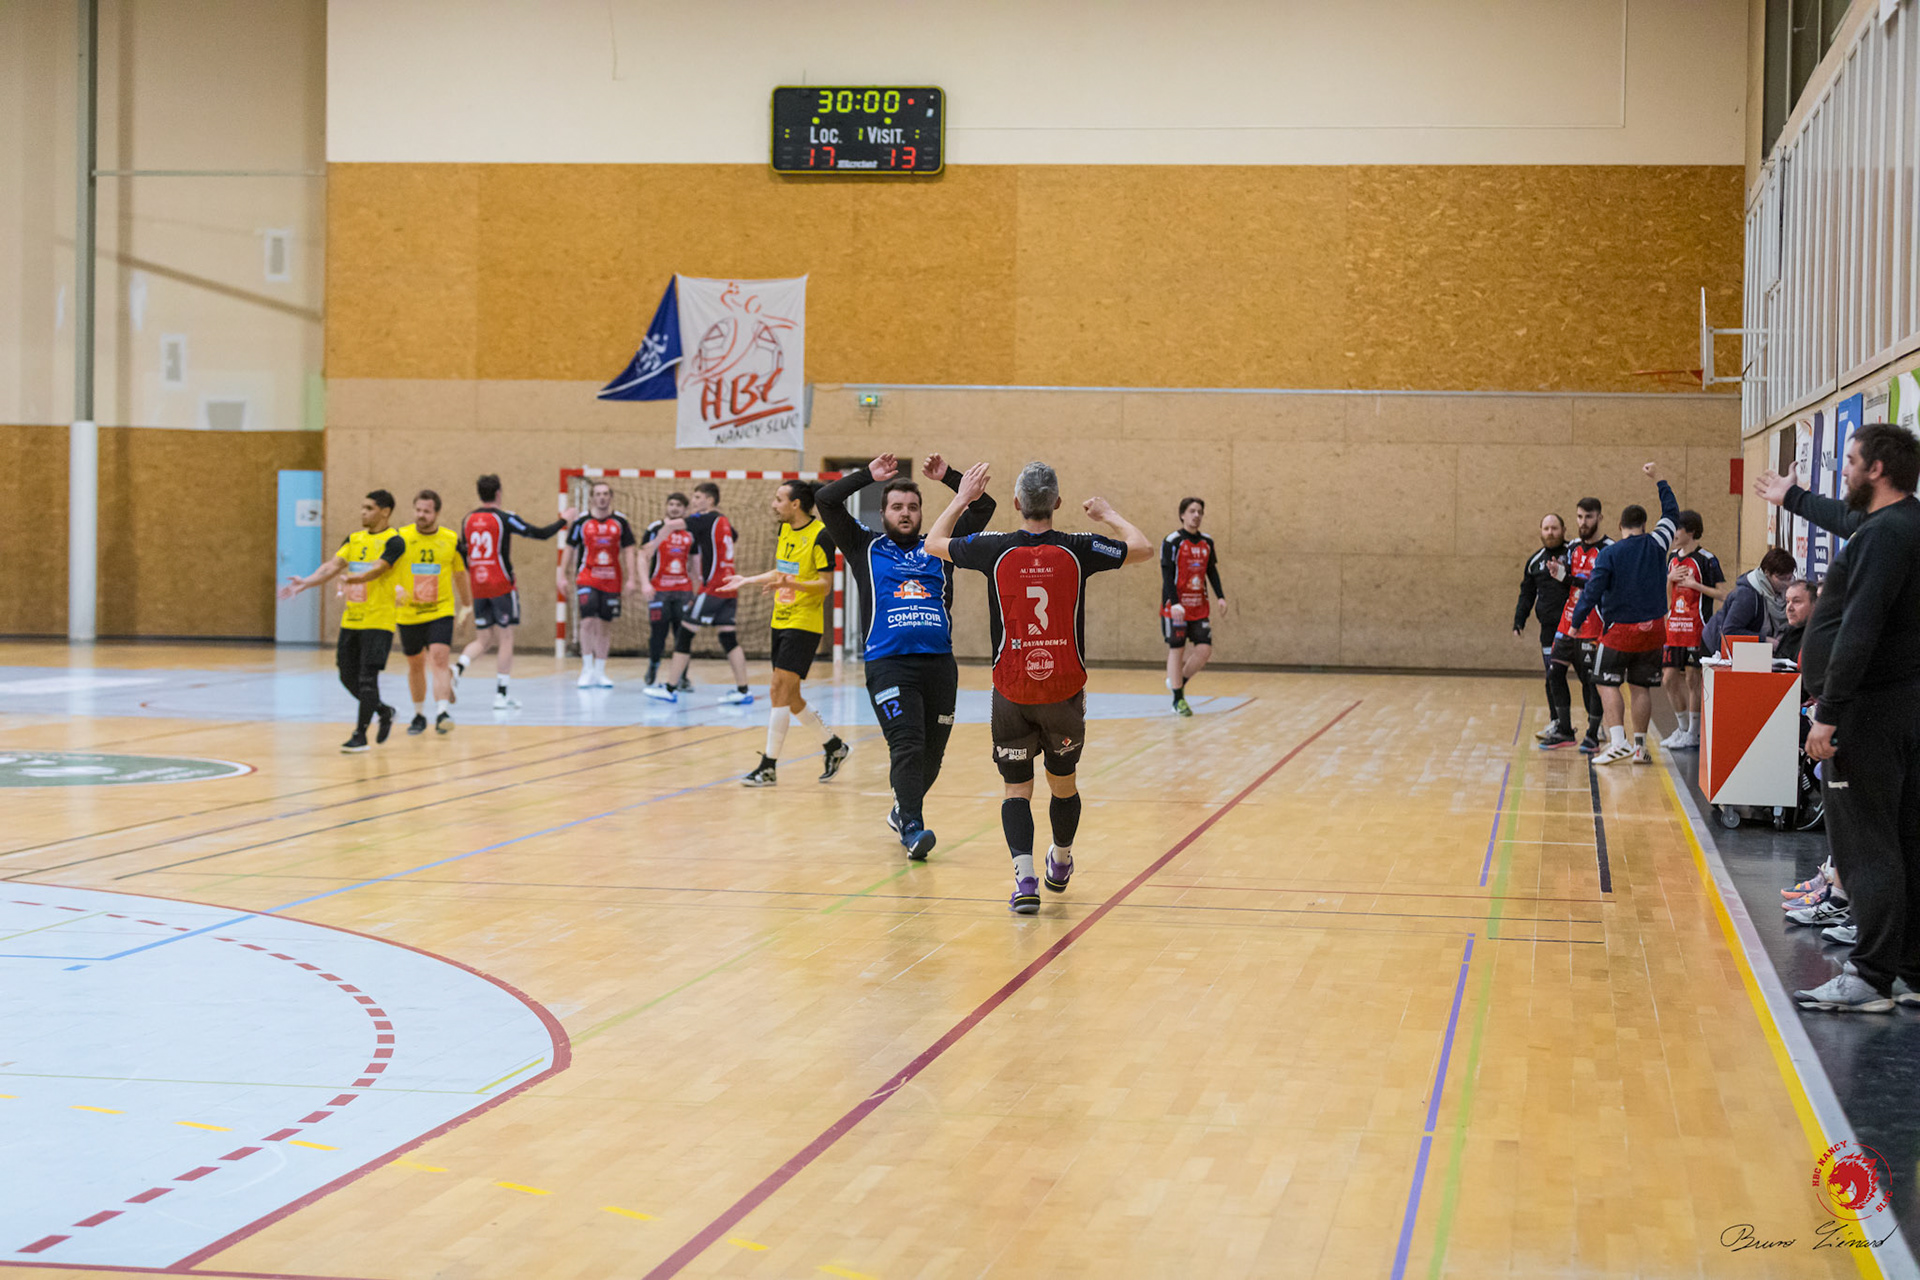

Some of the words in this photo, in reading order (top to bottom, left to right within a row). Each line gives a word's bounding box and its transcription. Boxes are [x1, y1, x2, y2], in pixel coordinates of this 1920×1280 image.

[818, 90, 900, 113] 30:00
[809, 146, 835, 167] 17
[890, 146, 916, 169] 13
[701, 366, 789, 422] HBC
[715, 425, 763, 444] NANCY
[420, 548, 435, 562] 23
[784, 542, 795, 559] 17
[887, 612, 942, 623] COMPTOIR
[1026, 586, 1049, 635] 3
[1022, 640, 1044, 648] RAYAN
[882, 700, 903, 720] 12
